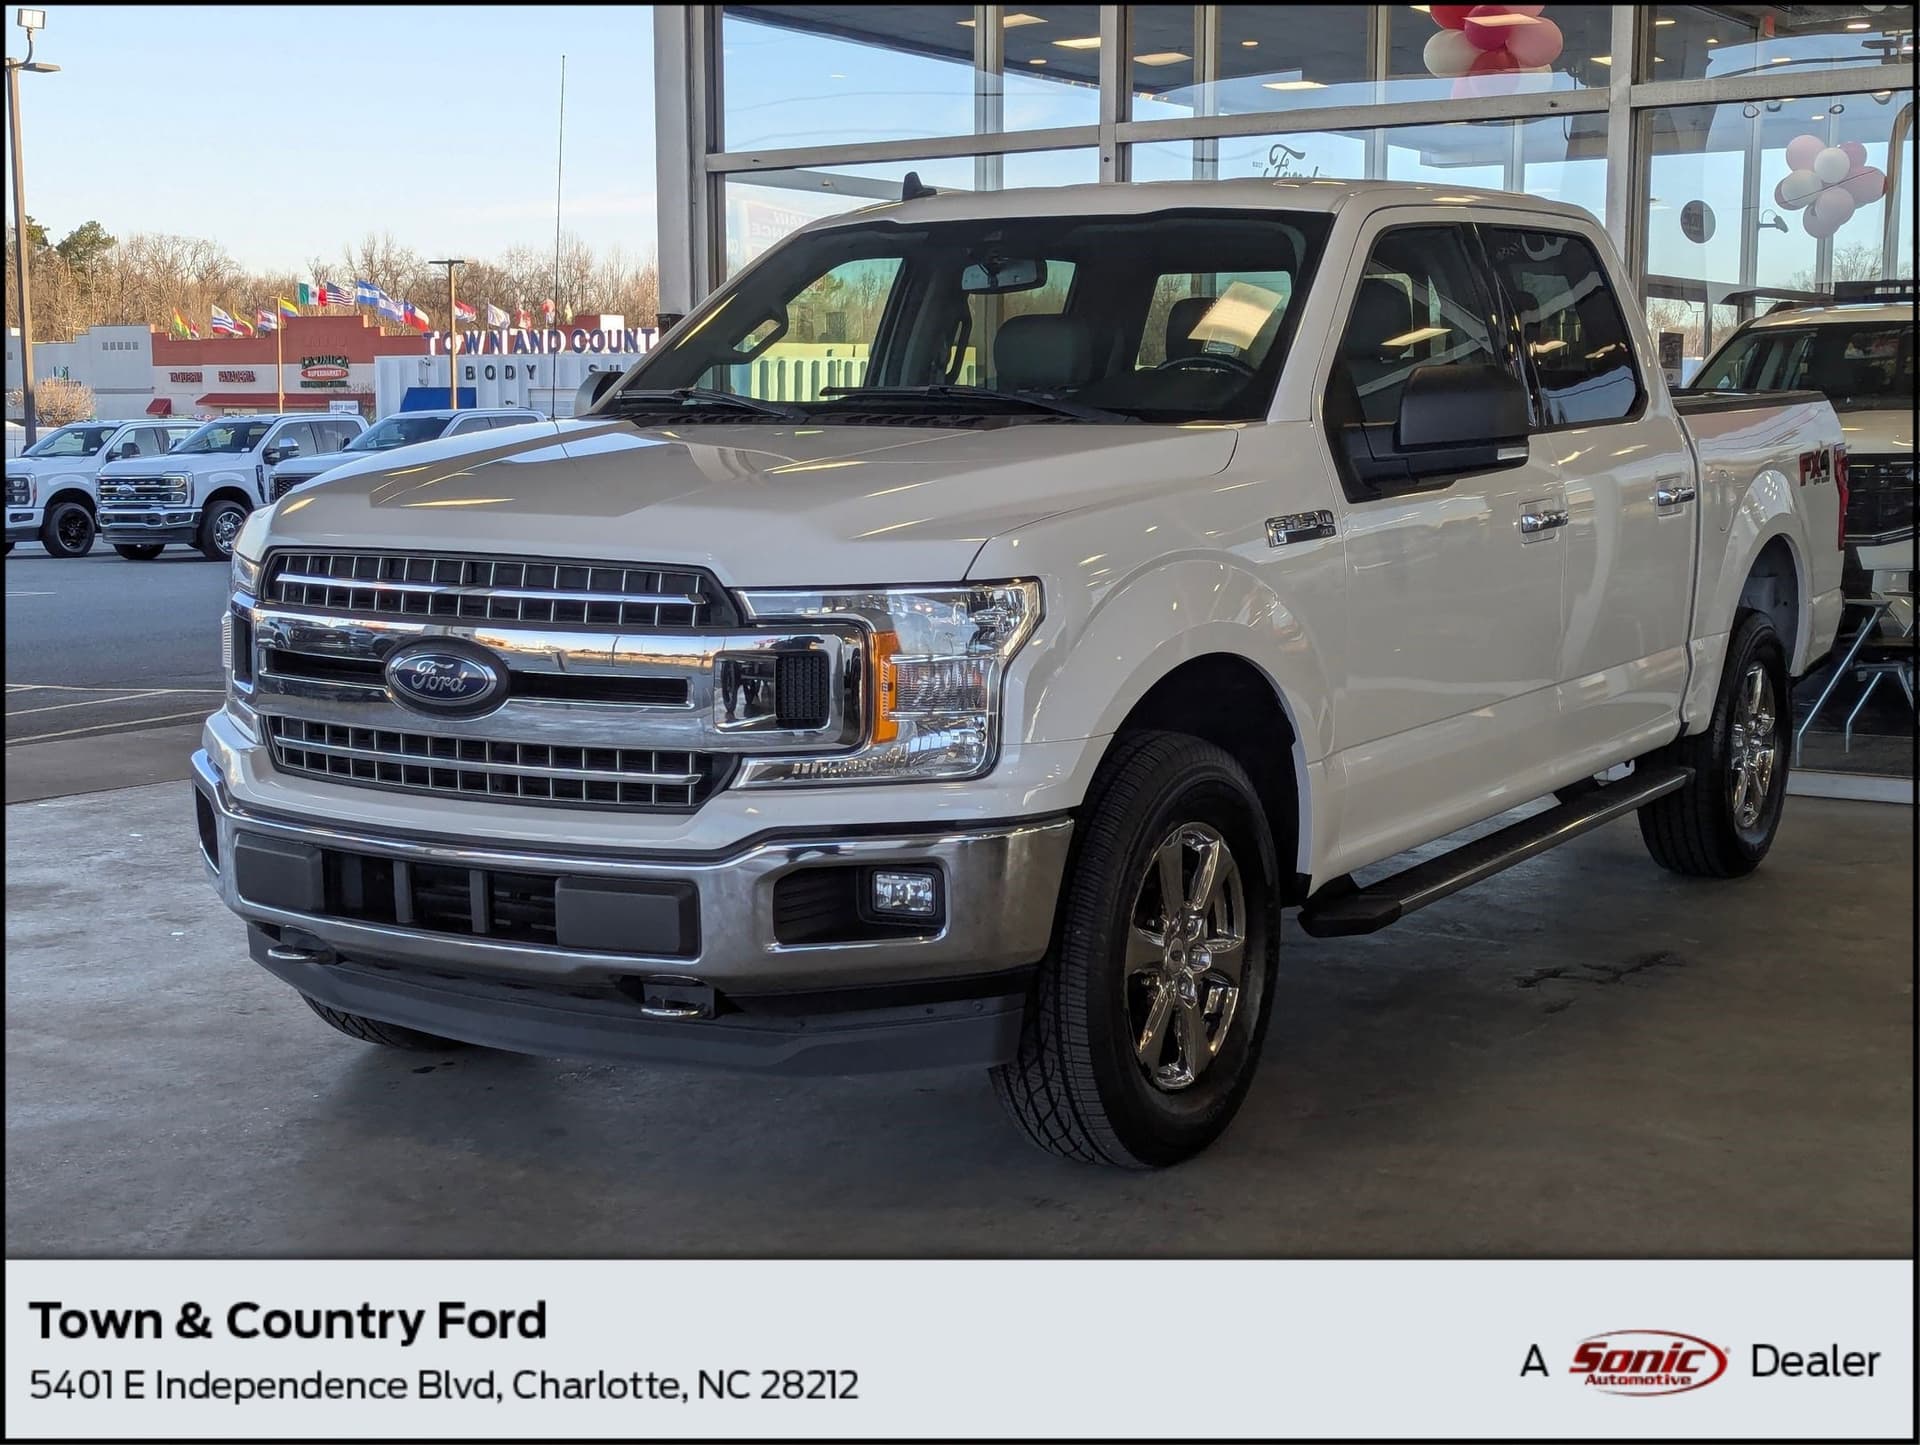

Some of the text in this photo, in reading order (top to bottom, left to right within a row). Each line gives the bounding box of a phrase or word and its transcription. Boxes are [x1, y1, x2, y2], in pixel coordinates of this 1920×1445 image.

[423, 328, 658, 355] TOWN AND COUNT
[465, 364, 537, 380] BODY
[1799, 449, 1830, 486] FX4
[411, 660, 467, 692] Ford
